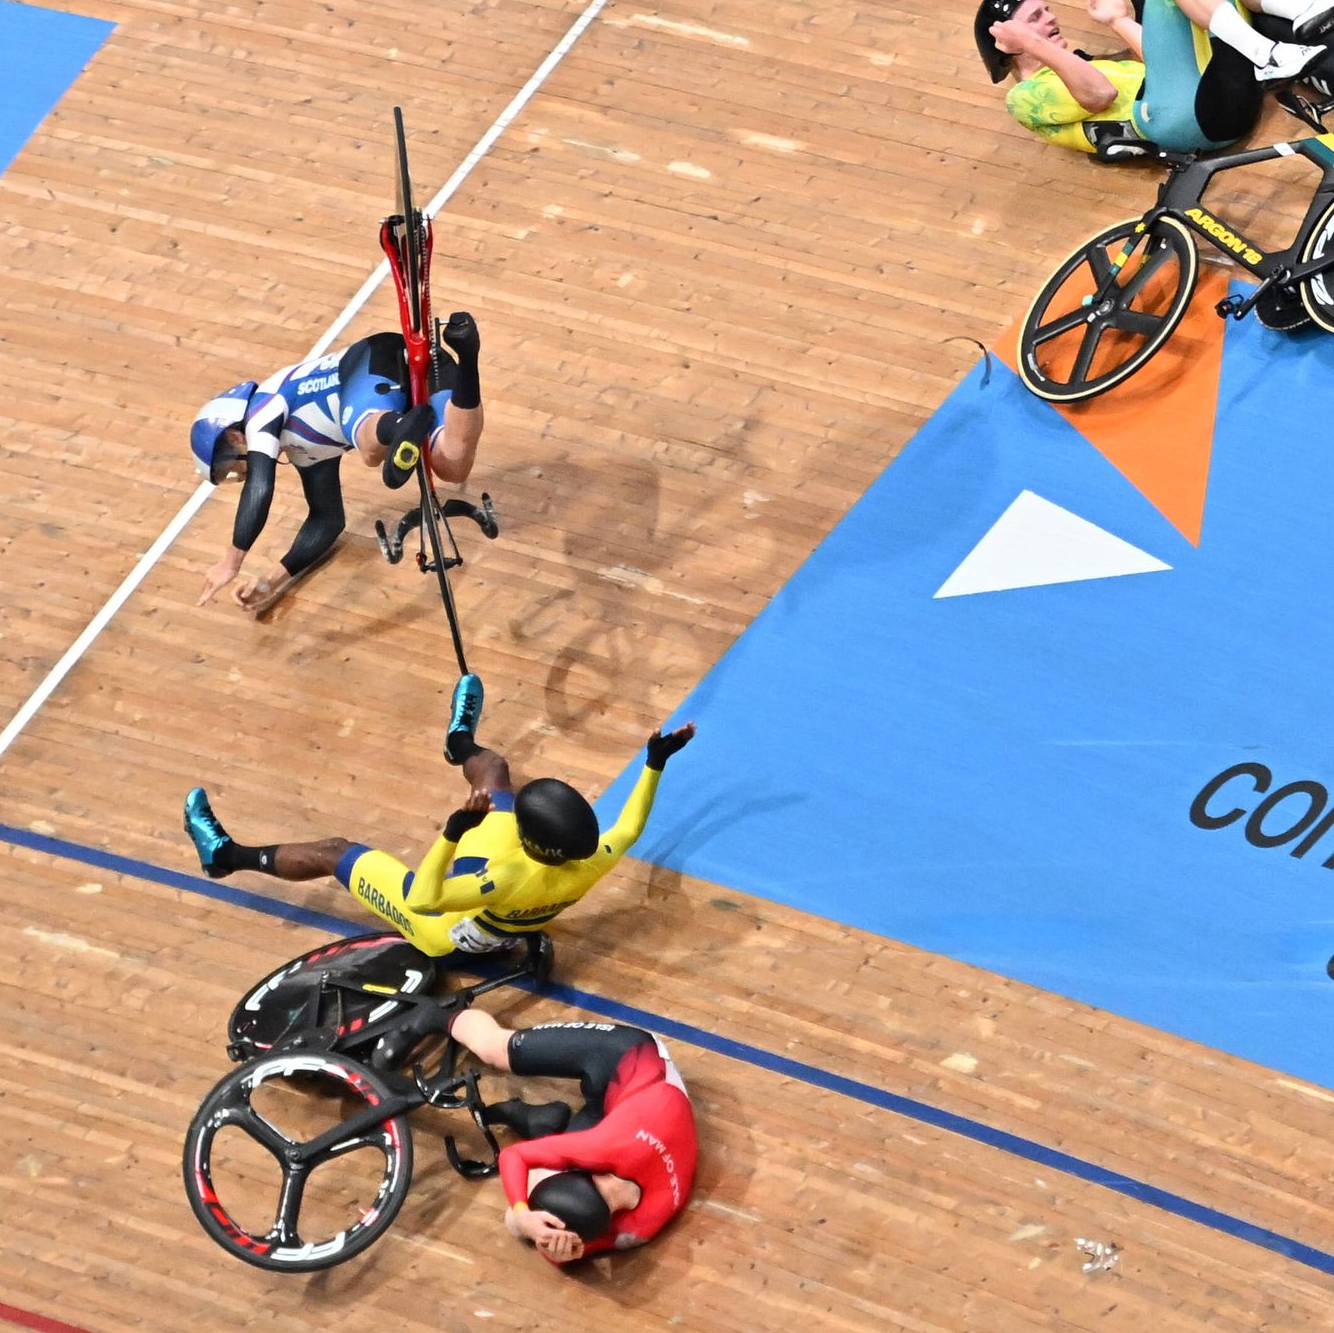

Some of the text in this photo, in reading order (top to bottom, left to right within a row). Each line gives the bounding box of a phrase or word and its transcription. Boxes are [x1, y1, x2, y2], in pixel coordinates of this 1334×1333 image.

[1184, 208, 1264, 266] ARGON 18
[297, 372, 341, 395] SCOTLAN
[357, 876, 415, 938] BARBADOS
[636, 1129, 667, 1154] MAN
[662, 1151, 675, 1172] OF
